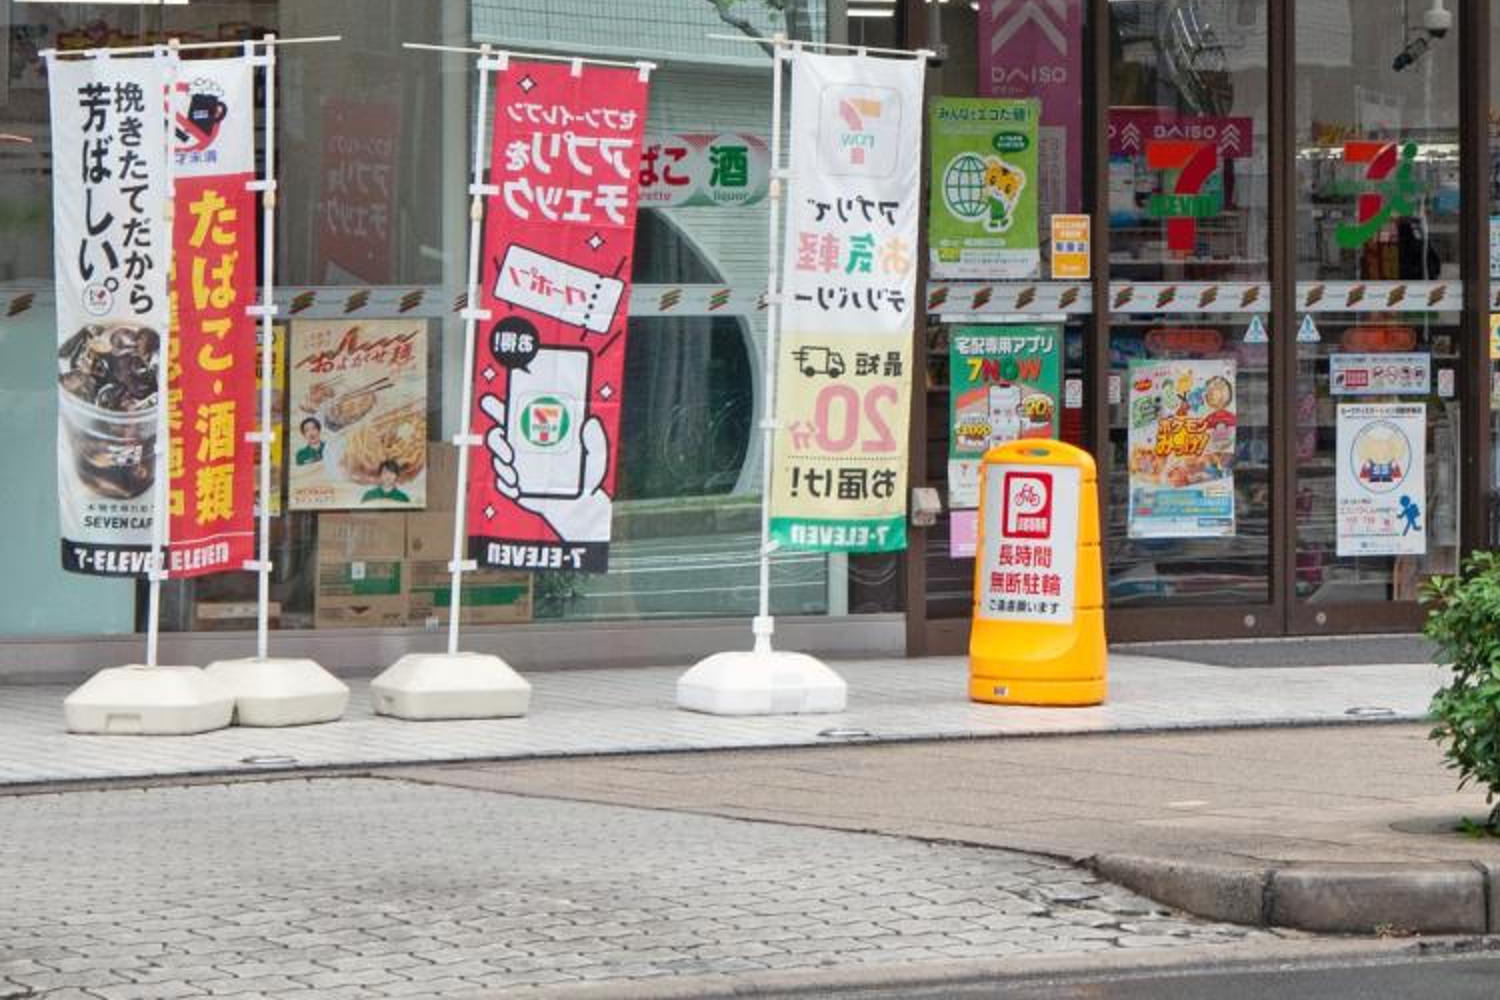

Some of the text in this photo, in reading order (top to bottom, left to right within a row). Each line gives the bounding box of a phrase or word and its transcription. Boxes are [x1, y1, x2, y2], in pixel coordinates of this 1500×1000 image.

[991, 66, 1067, 83] DAISO
[1153, 124, 1217, 139] DAISO
[638, 143, 690, 186] ばこ
[708, 145, 749, 187] 酒
[77, 81, 119, 293] 芳ばしい。
[114, 81, 154, 315] 挽きたてだから
[84, 514, 154, 530] SEVEN CAF
[73, 547, 166, 573] 7-ELEVE
[998, 544, 1054, 569] 長時間
[989, 571, 1063, 597] 無断駐輪
